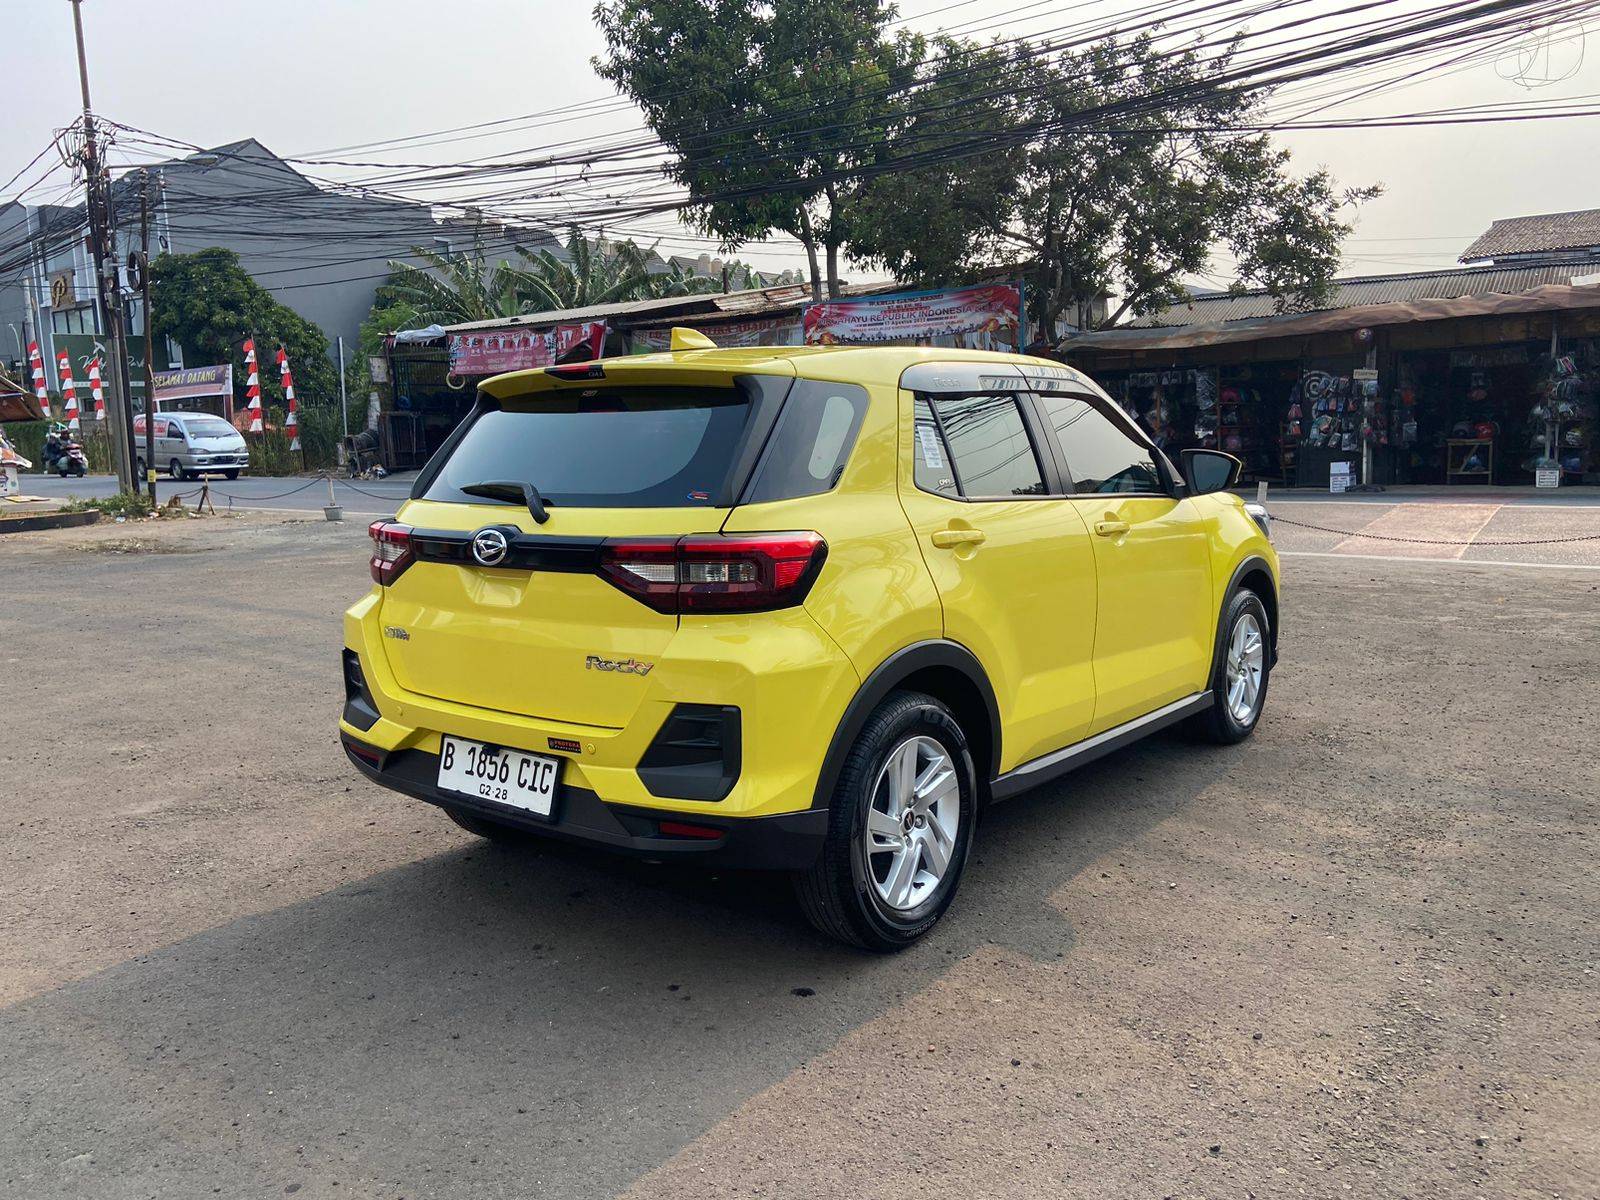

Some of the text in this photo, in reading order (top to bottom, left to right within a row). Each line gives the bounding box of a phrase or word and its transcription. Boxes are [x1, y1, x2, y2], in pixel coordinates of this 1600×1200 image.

[870, 311, 916, 322] REPUBLIK
[918, 304, 972, 317] INDONESIA
[154, 370, 216, 387] SELAMAT DATANG
[585, 655, 655, 676] Rocky
[443, 742, 553, 794] B 1856 CIC
